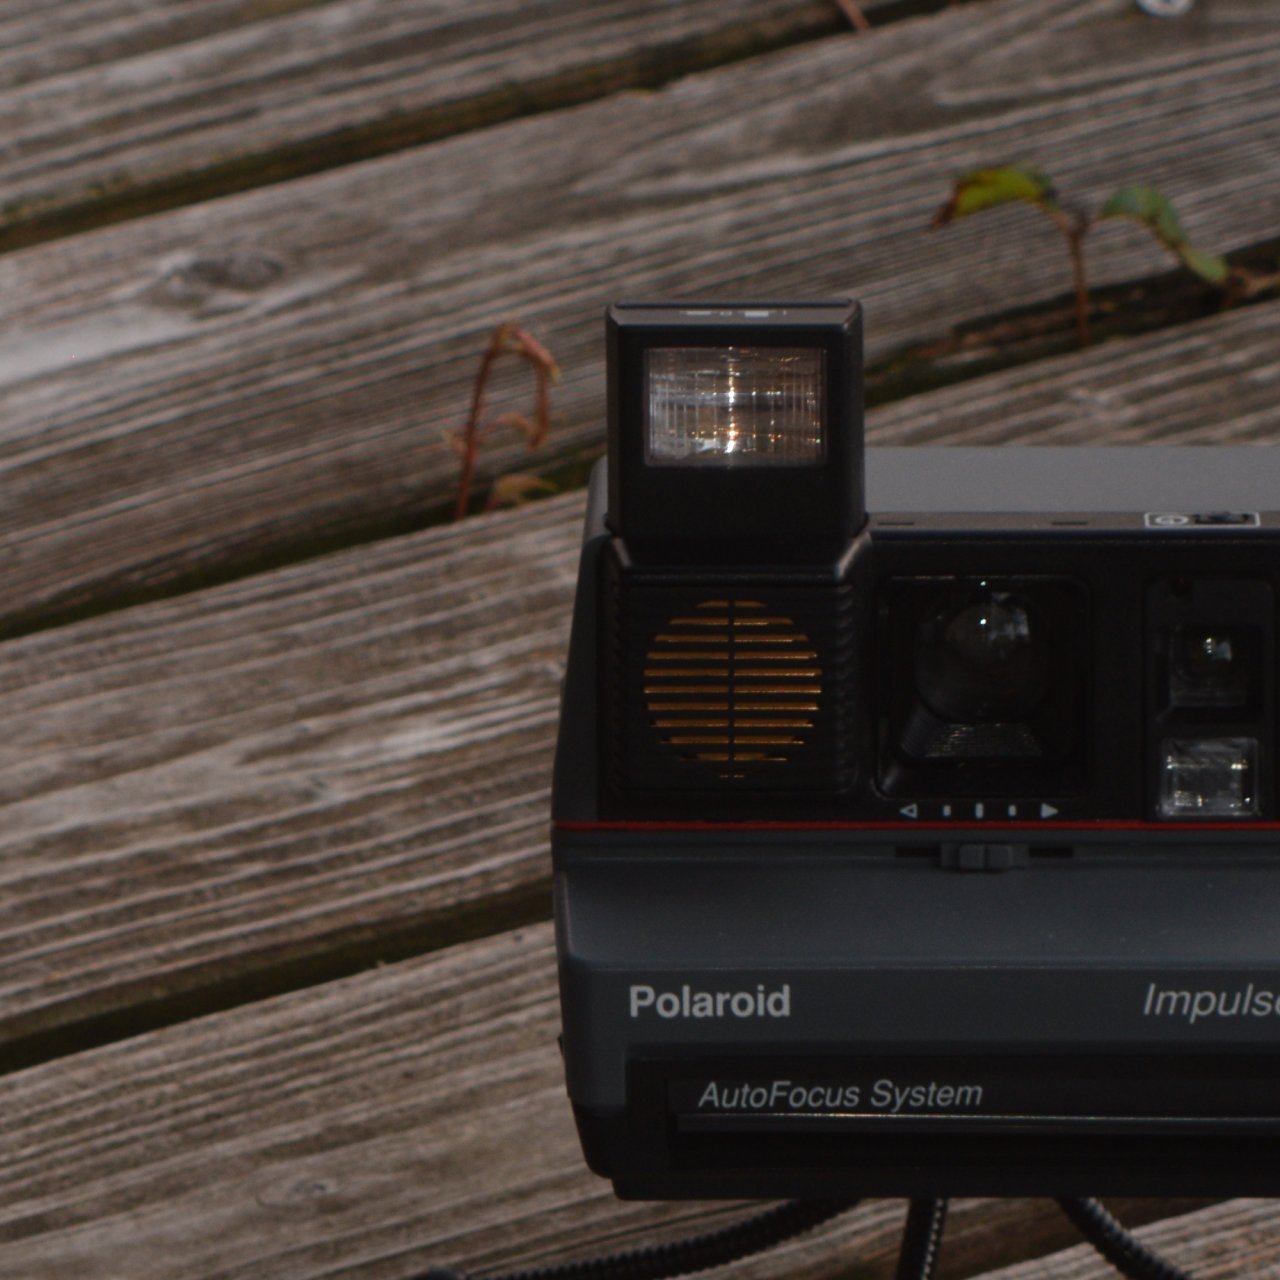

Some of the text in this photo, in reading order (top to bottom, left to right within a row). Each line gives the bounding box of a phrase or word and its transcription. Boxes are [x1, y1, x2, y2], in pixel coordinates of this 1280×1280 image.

[629, 984, 790, 1018] Polaroid
[699, 1080, 983, 1112] AutoFocus System
